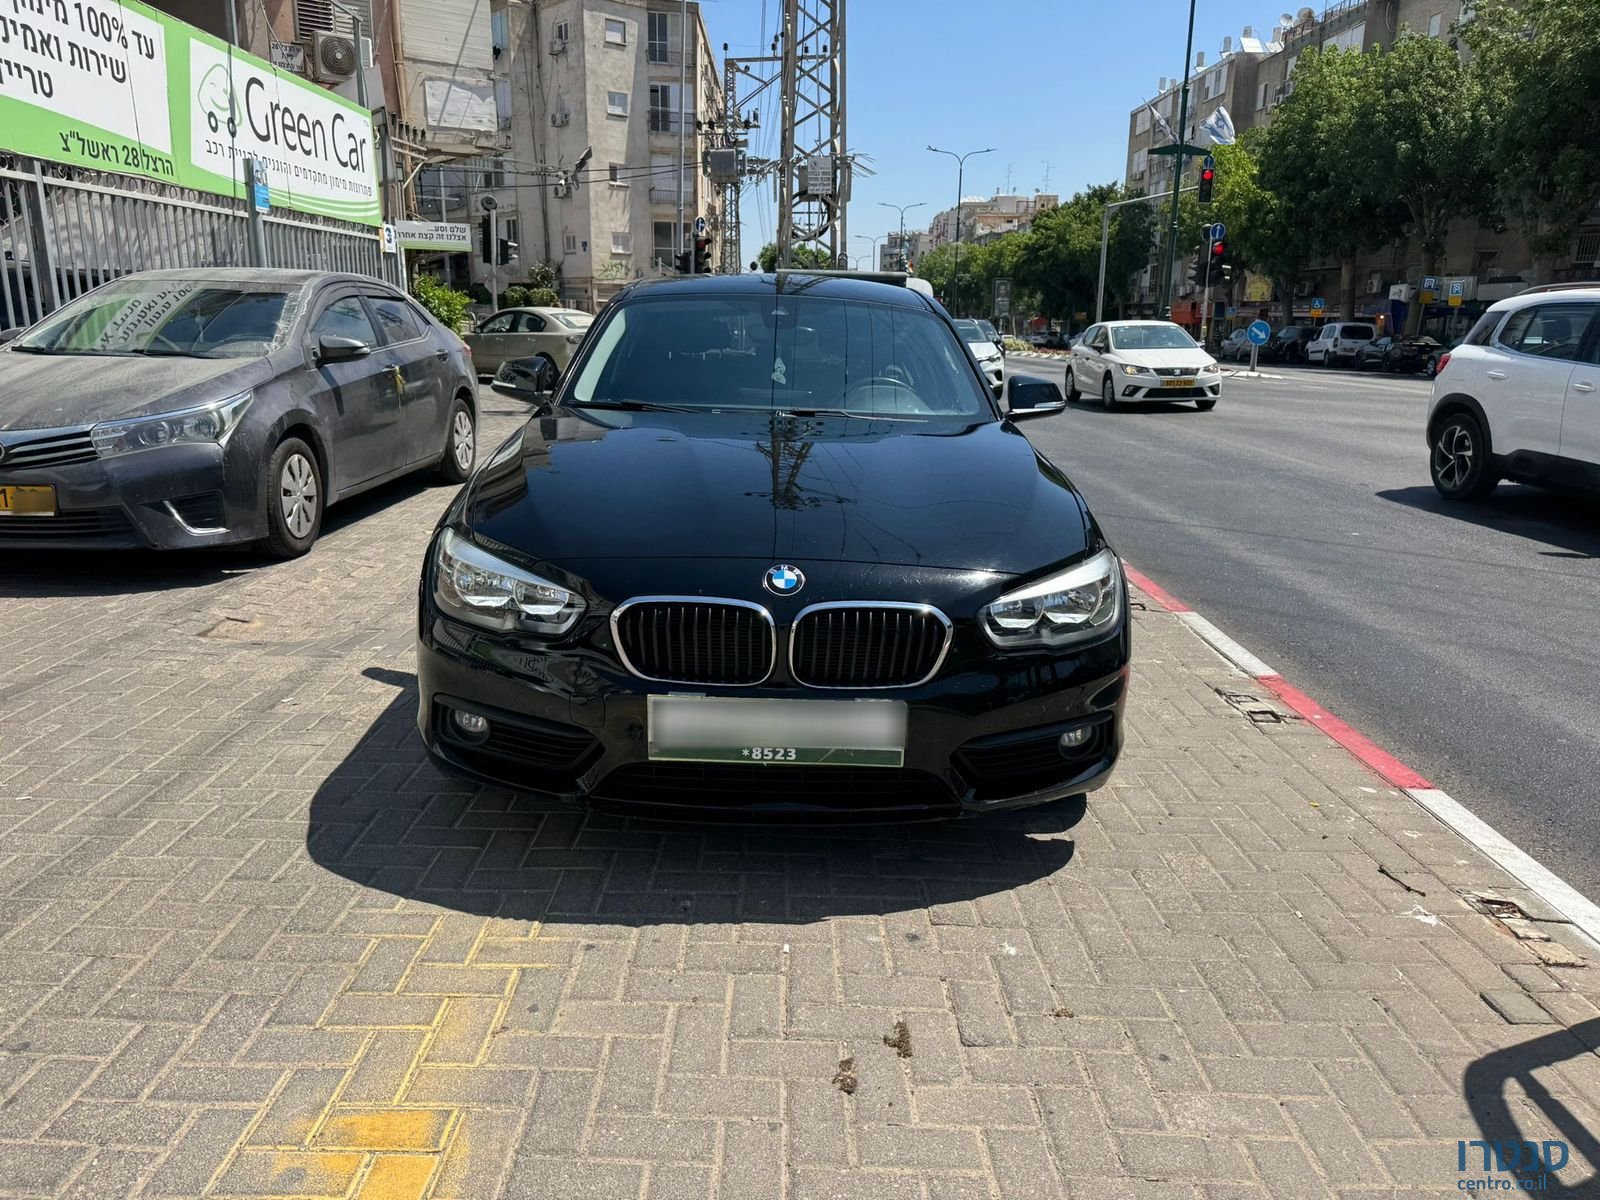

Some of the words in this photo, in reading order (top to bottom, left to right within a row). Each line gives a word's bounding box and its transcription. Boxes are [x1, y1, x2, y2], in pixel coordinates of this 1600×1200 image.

[74, 2, 128, 50] 100%
[131, 30, 155, 60] עד
[68, 40, 127, 83] שירות
[245, 76, 328, 162] Green
[331, 112, 367, 173] Car
[121, 145, 140, 168] 28
[205, 138, 225, 157] רכב
[142, 148, 174, 176] הרצל
[294, 165, 328, 185] מתקדמים
[418, 232, 434, 241] קצת
[446, 232, 467, 240] אצלנו
[450, 225, 466, 233] שלם
